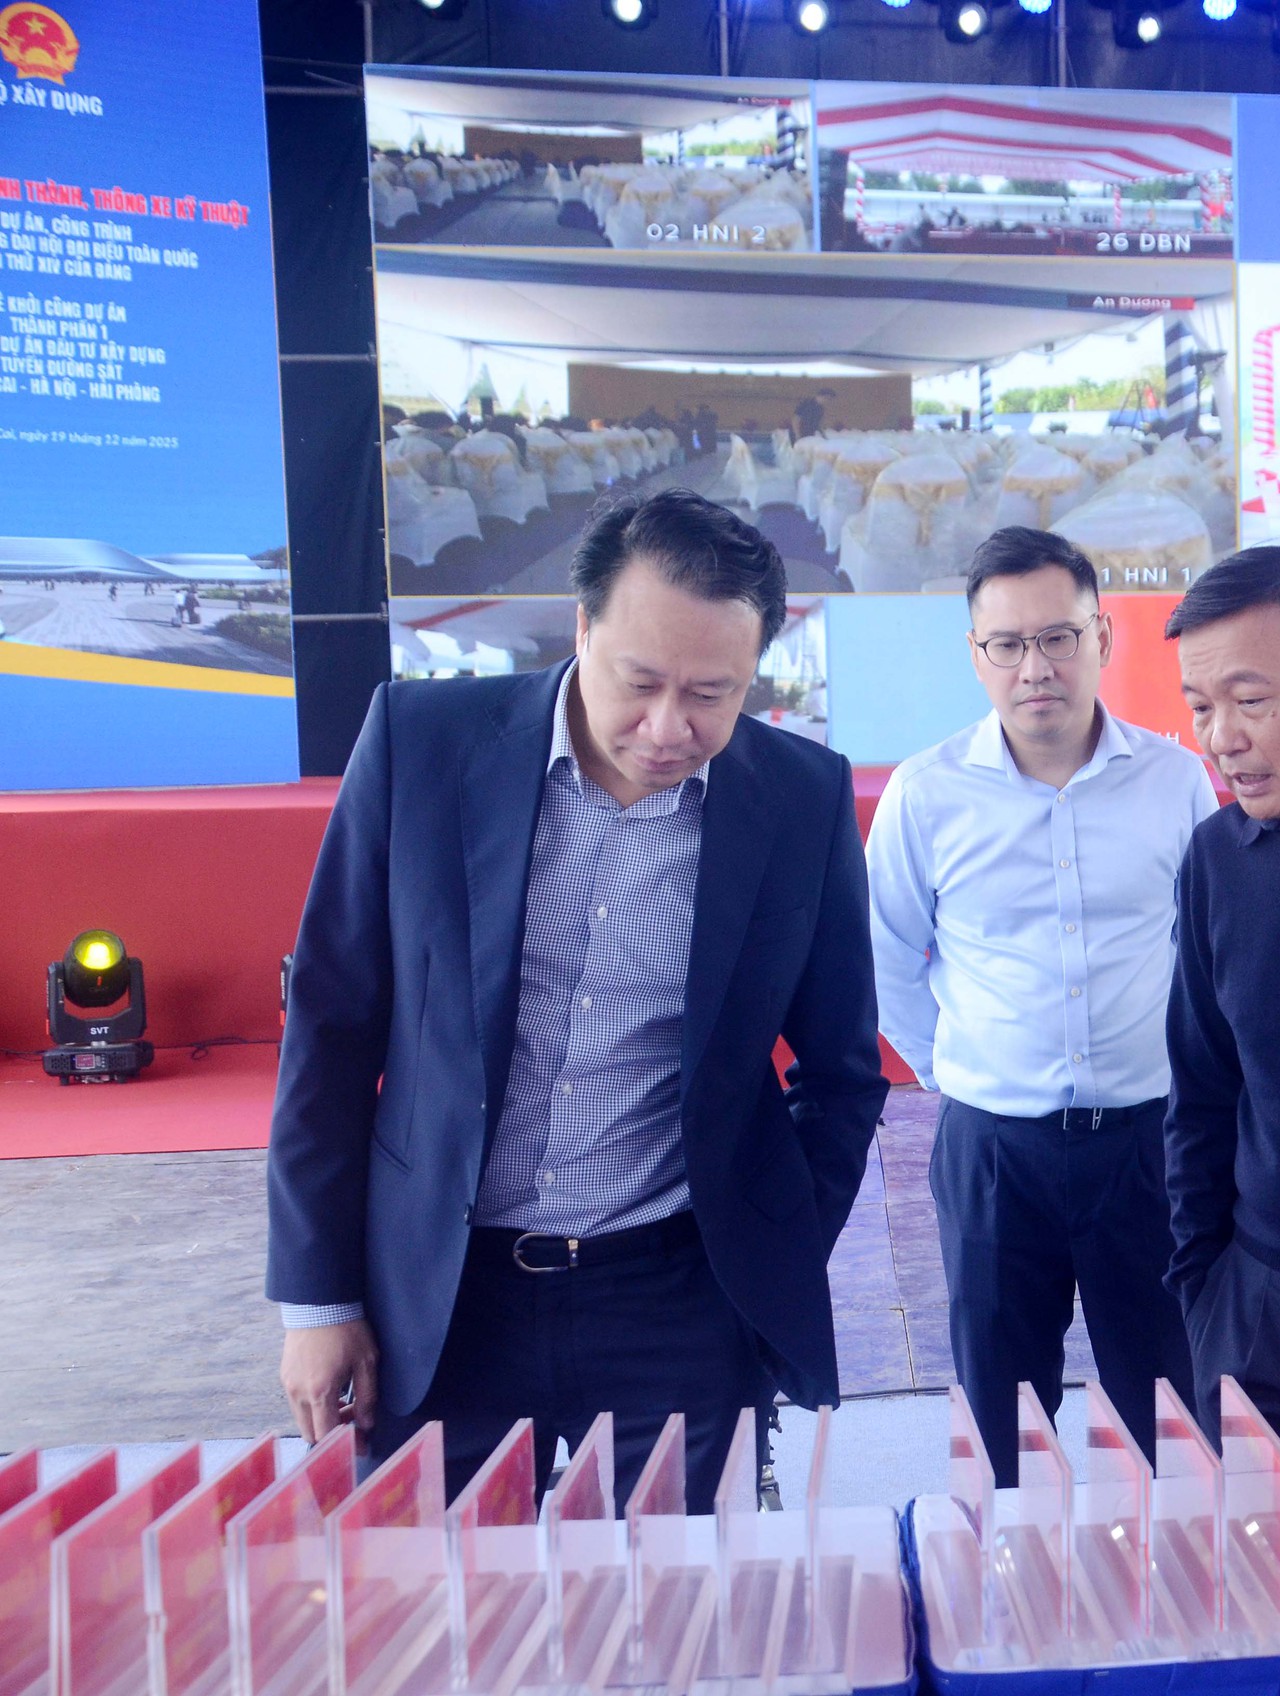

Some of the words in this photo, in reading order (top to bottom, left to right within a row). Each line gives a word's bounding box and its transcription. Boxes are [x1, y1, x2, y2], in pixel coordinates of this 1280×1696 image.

[10, 81, 46, 108] XÂY
[50, 90, 104, 116] DỰNG
[647, 223, 680, 242] 02
[693, 224, 739, 243] HNI
[752, 225, 767, 243] 2
[1096, 232, 1129, 251] 26
[1125, 567, 1168, 583] HNI
[1182, 567, 1192, 583] 1
[90, 1026, 109, 1035] SVT
